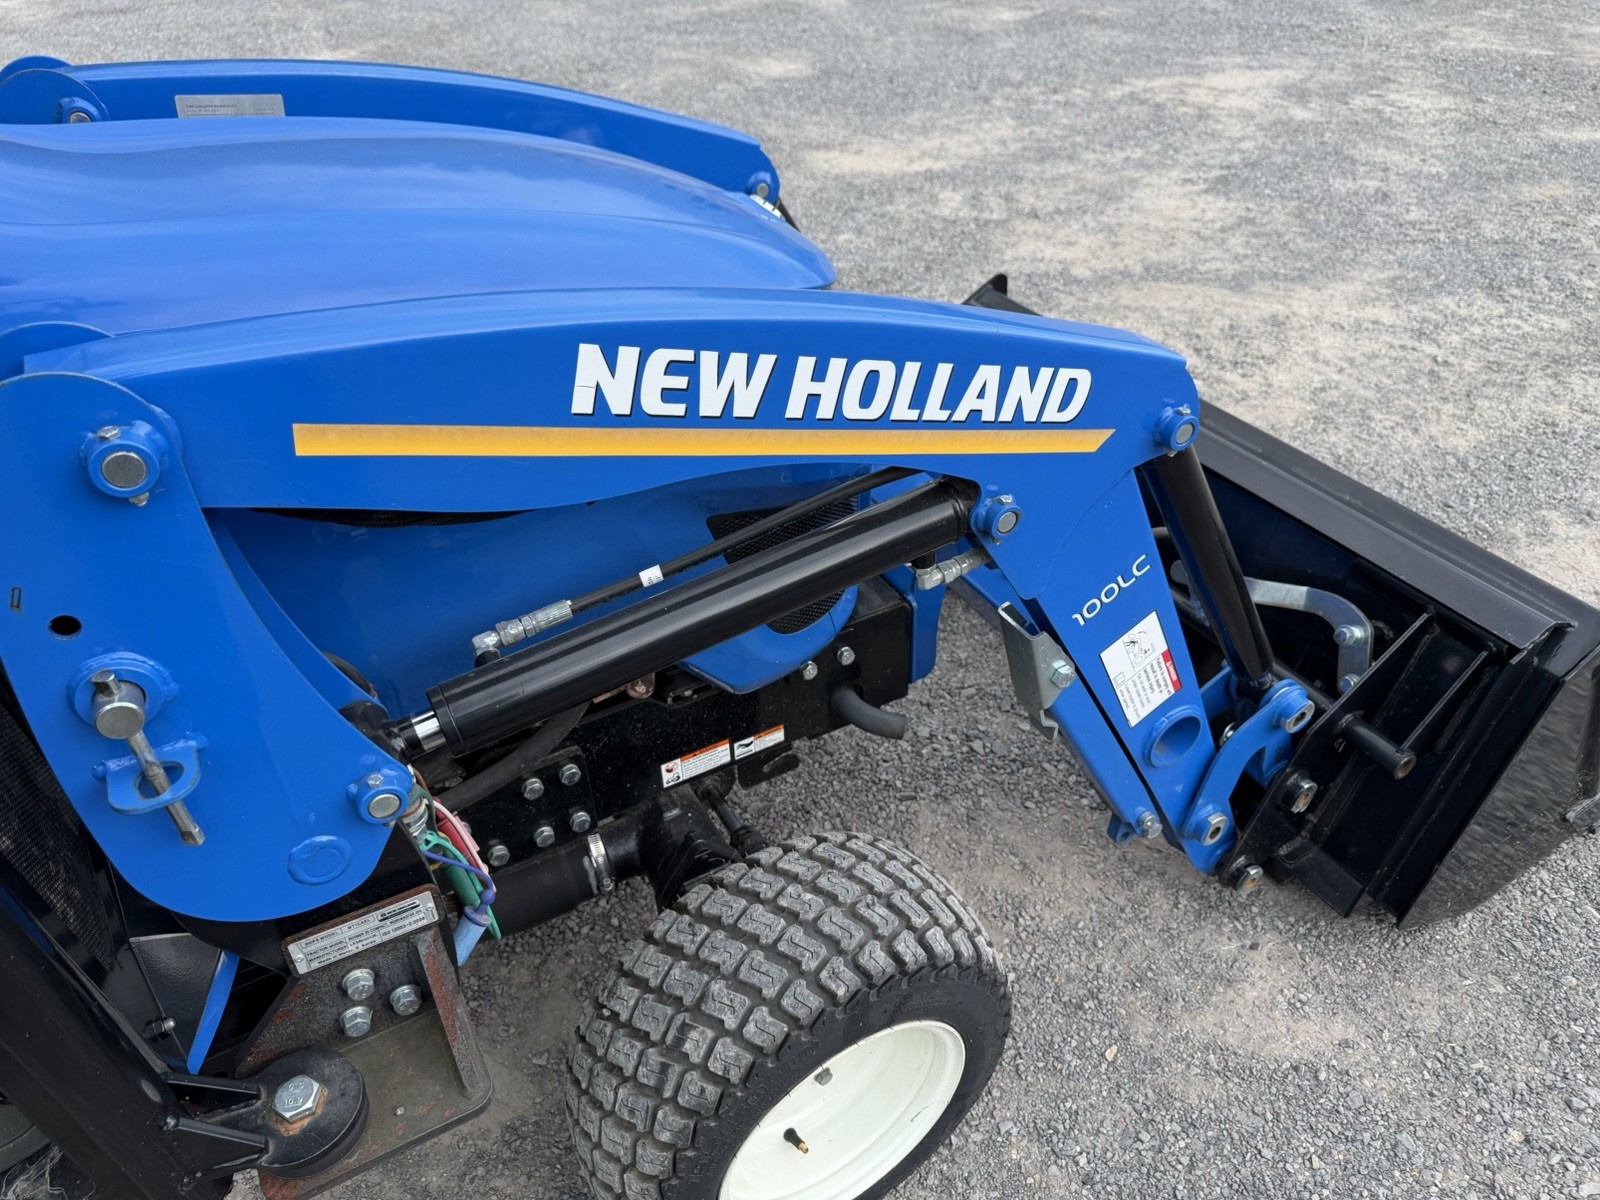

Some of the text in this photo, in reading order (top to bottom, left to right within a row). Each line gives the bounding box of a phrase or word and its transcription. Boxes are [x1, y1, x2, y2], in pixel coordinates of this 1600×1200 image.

[571, 343, 1092, 423] NEW HOLLAND
[1072, 554, 1151, 627] 100LC
